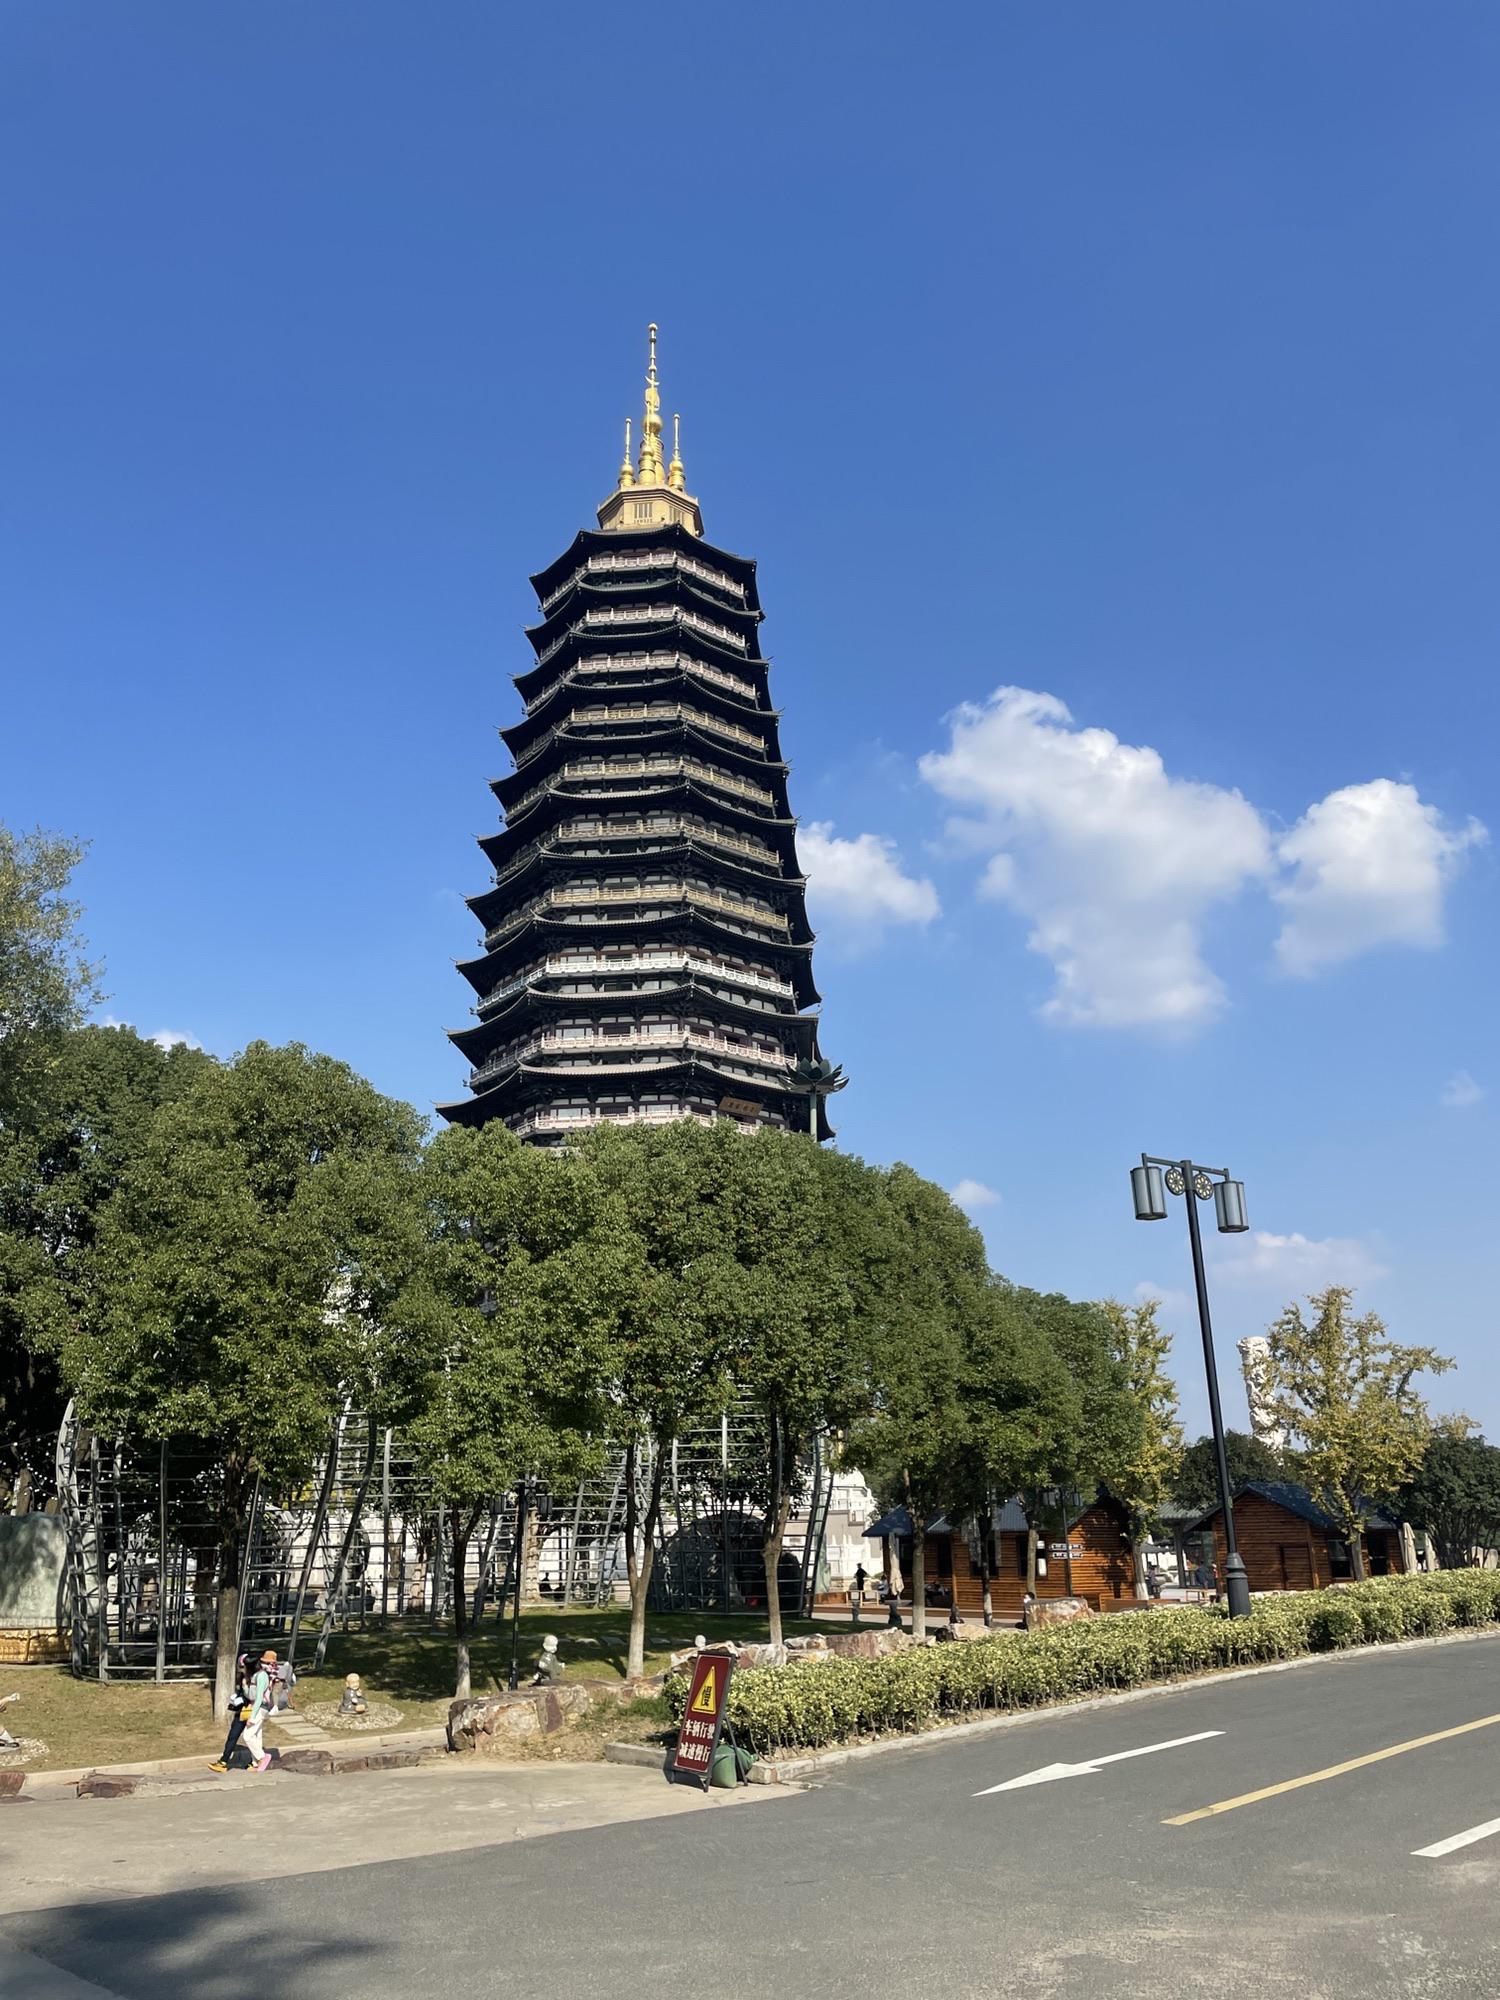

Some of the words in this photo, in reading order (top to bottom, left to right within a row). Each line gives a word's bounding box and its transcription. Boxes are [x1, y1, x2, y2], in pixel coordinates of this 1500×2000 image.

[701, 1686, 712, 1706] 慢
[684, 1719, 715, 1739] 车辆行驶
[679, 1742, 711, 1762] 减速慢行
